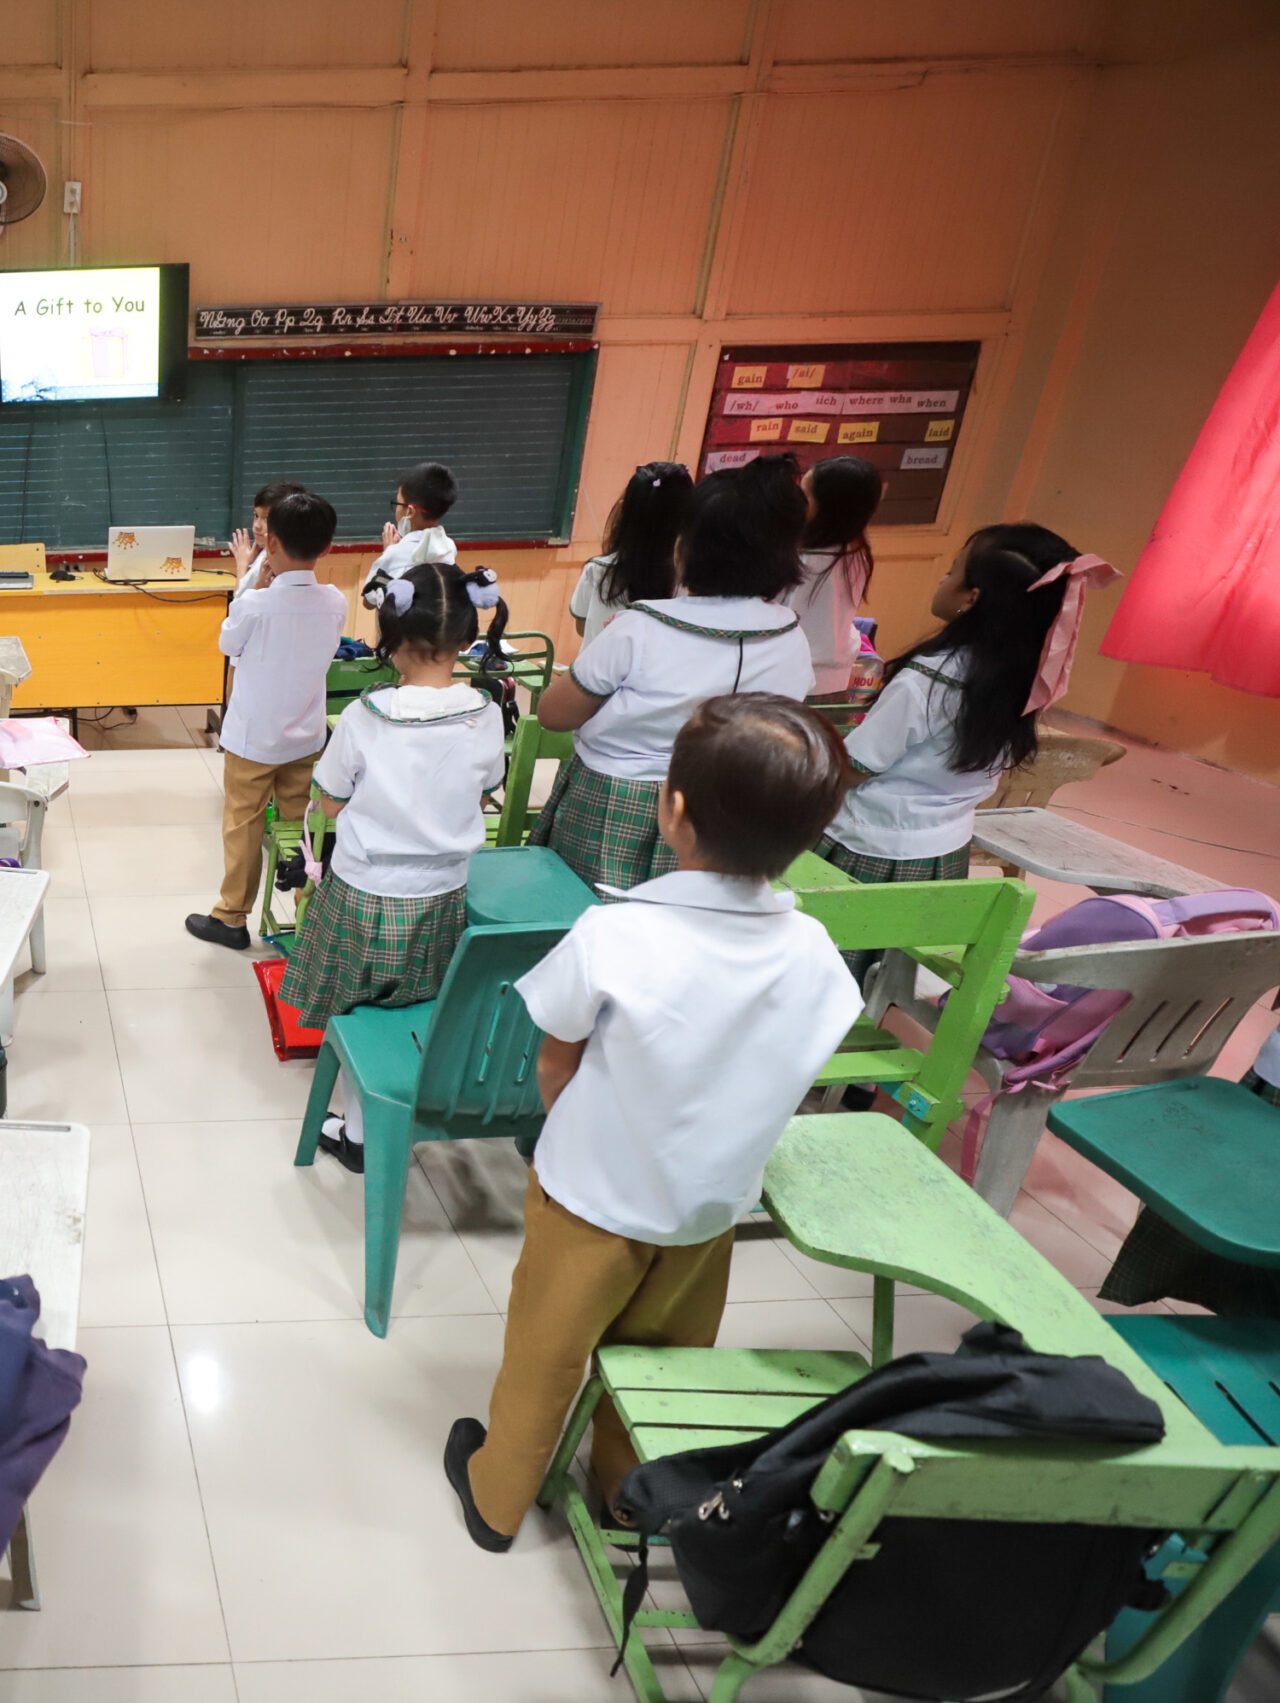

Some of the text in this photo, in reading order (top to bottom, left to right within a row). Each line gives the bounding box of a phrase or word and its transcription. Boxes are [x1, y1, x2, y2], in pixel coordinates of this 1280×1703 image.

[14, 296, 145, 316] A Gift to You
[251, 309, 271, 327] Oo
[275, 309, 295, 333] Pp
[737, 373, 763, 386] gain
[730, 400, 759, 412] /wh/
[775, 401, 799, 410] who
[849, 395, 884, 406] where
[889, 394, 912, 404] wha
[917, 398, 947, 408] when
[756, 421, 779, 432] rain
[794, 423, 818, 434] said
[842, 428, 873, 441] again
[720, 452, 938, 465] dead bread
